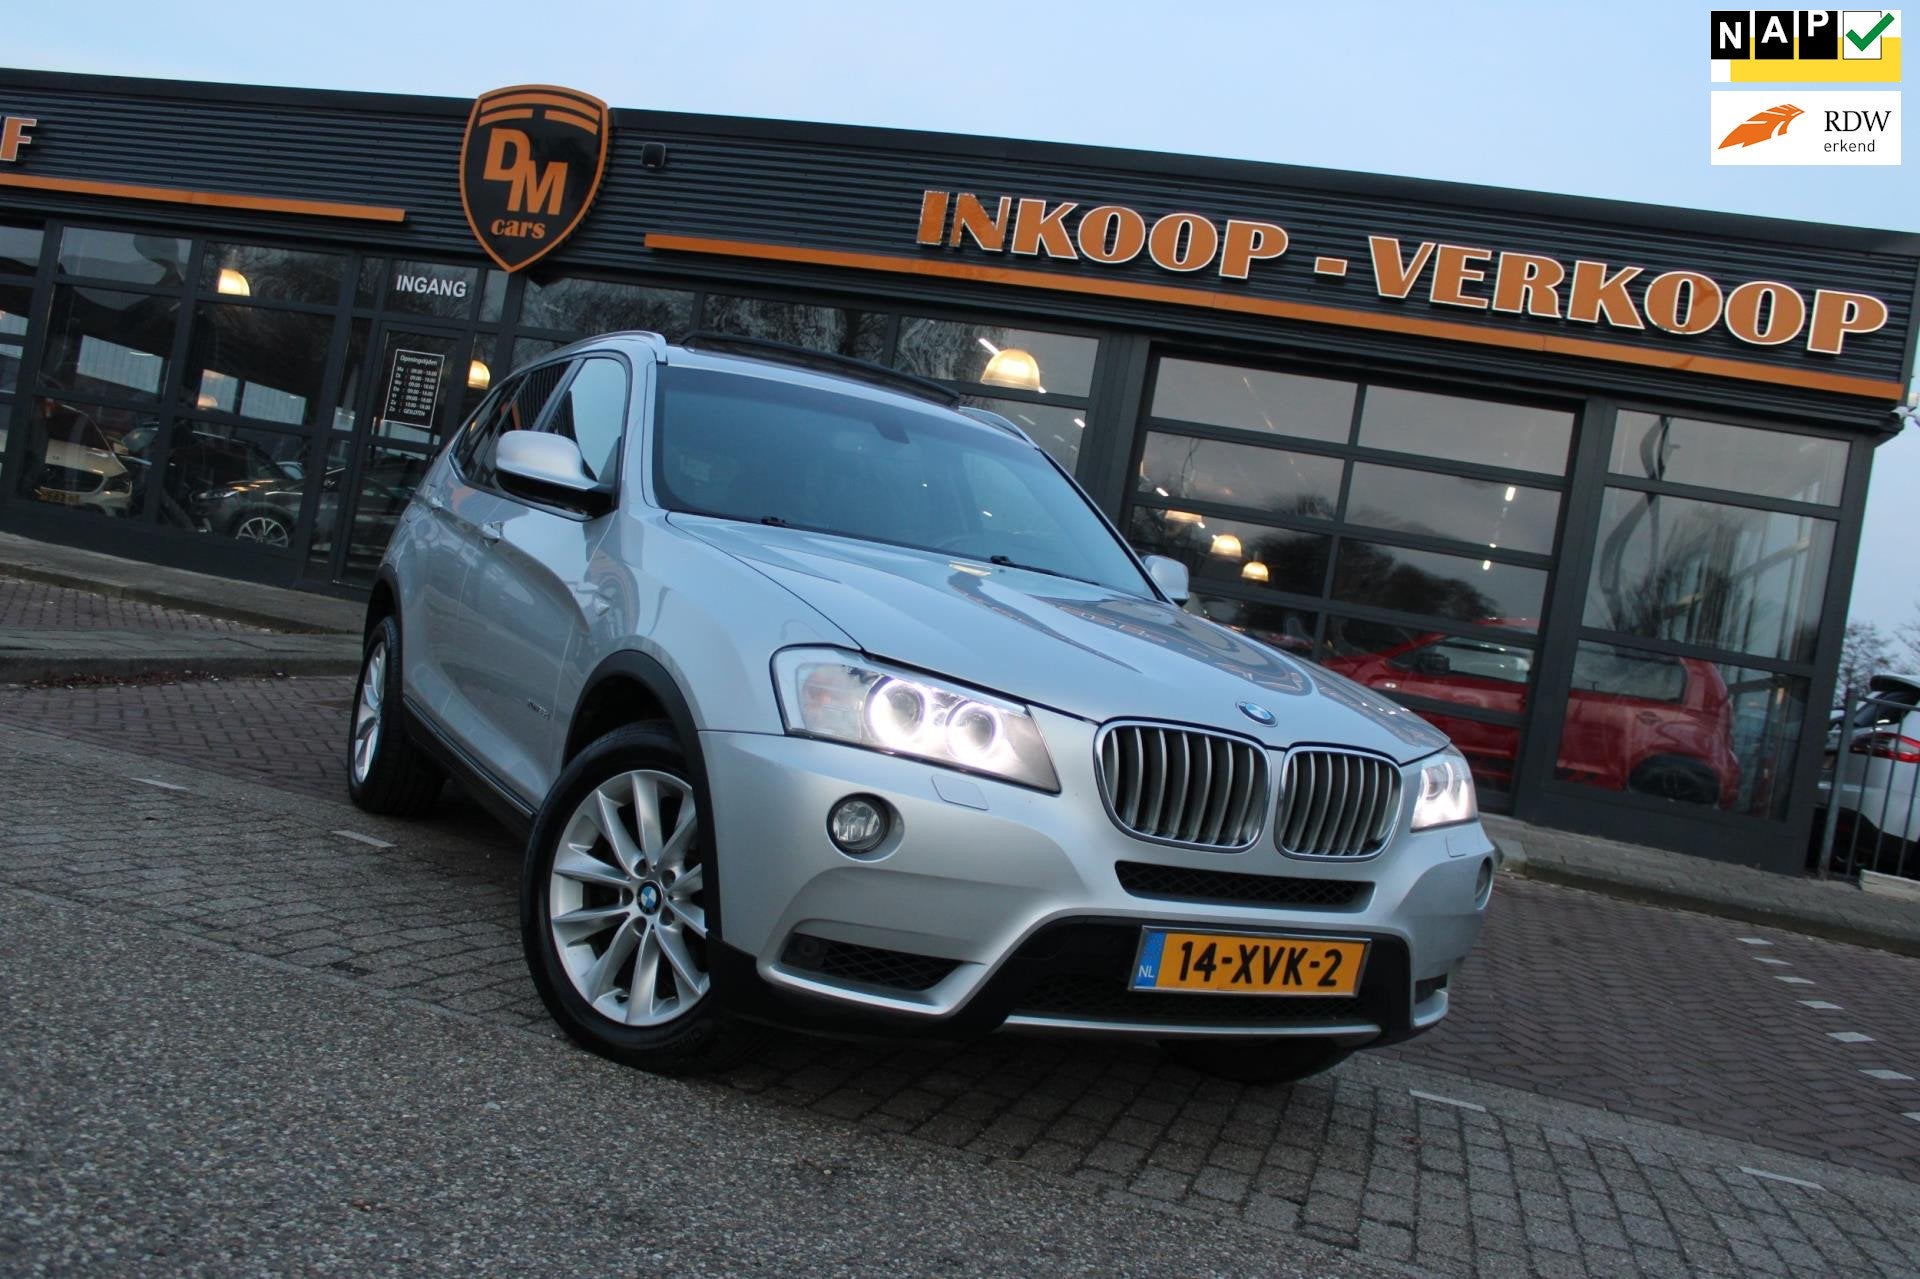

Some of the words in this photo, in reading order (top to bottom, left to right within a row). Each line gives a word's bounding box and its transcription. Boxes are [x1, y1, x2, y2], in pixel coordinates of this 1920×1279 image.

[483, 127, 569, 216] DM
[491, 218, 546, 239] cars
[396, 274, 467, 298] INGANG
[916, 190, 1289, 280] INKOOP
[1368, 235, 1889, 356] VERKOOP
[1138, 965, 1155, 978] NL
[1179, 940, 1343, 987] 14-XVK-2
